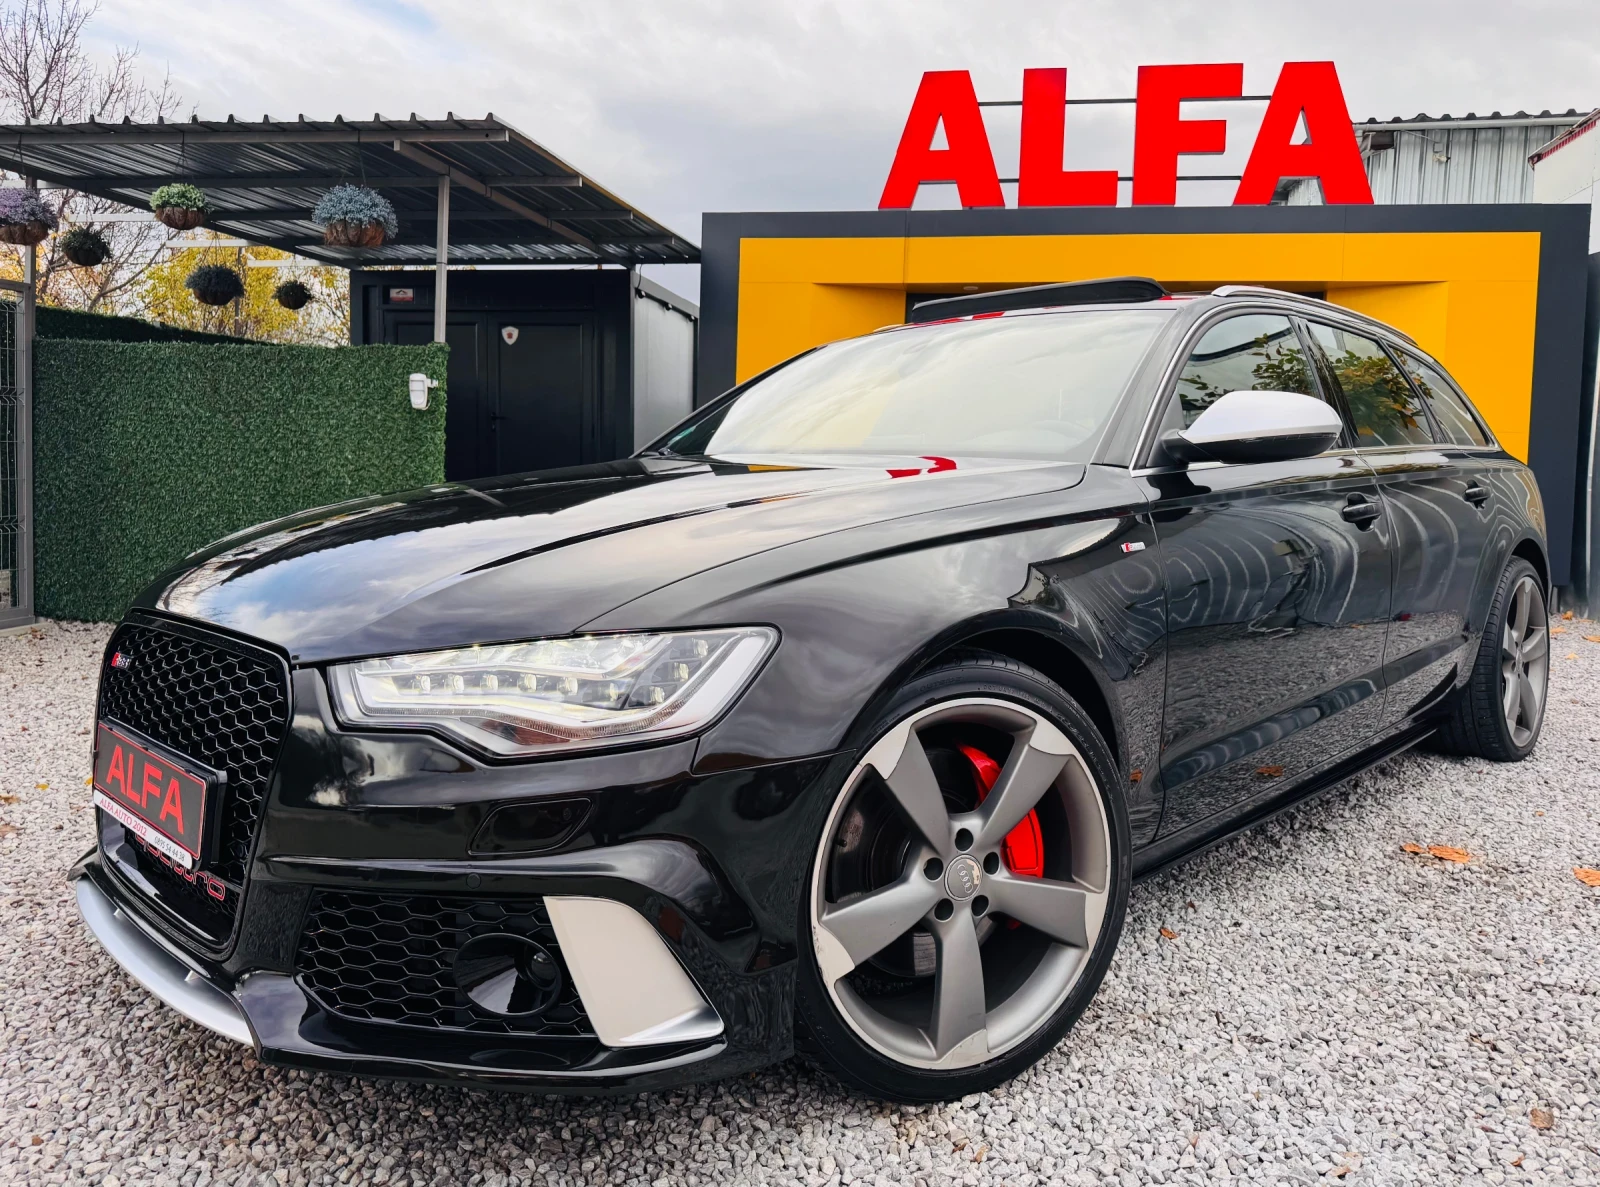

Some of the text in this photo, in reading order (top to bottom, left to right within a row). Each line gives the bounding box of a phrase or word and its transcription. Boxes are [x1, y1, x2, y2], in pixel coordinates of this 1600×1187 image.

[878, 61, 1374, 209] ALFA
[99, 797, 114, 815] ALFA
[114, 808, 133, 826] AUTO
[132, 820, 147, 837] 2012
[106, 744, 184, 835] ALFA
